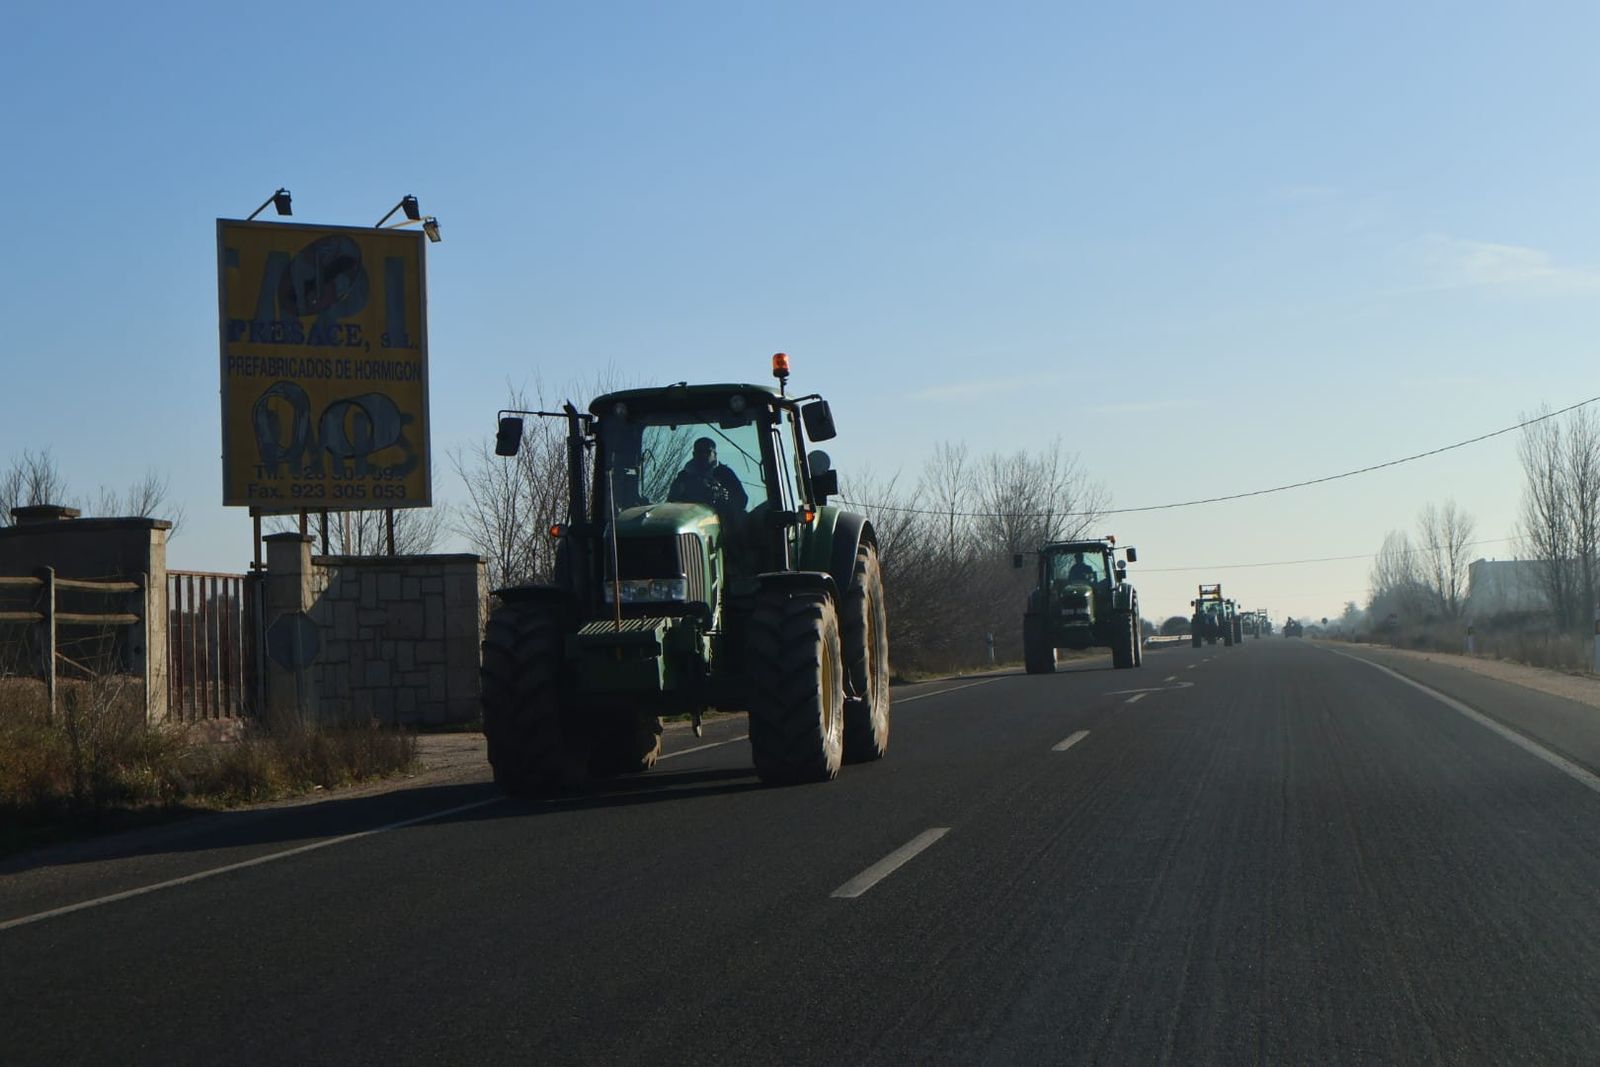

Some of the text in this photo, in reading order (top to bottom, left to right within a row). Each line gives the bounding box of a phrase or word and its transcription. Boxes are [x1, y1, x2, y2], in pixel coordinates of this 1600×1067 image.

[228, 355, 421, 381] PREFABRICADOS DE HORMIGON
[247, 483, 407, 499] Fax. 923 305 053
